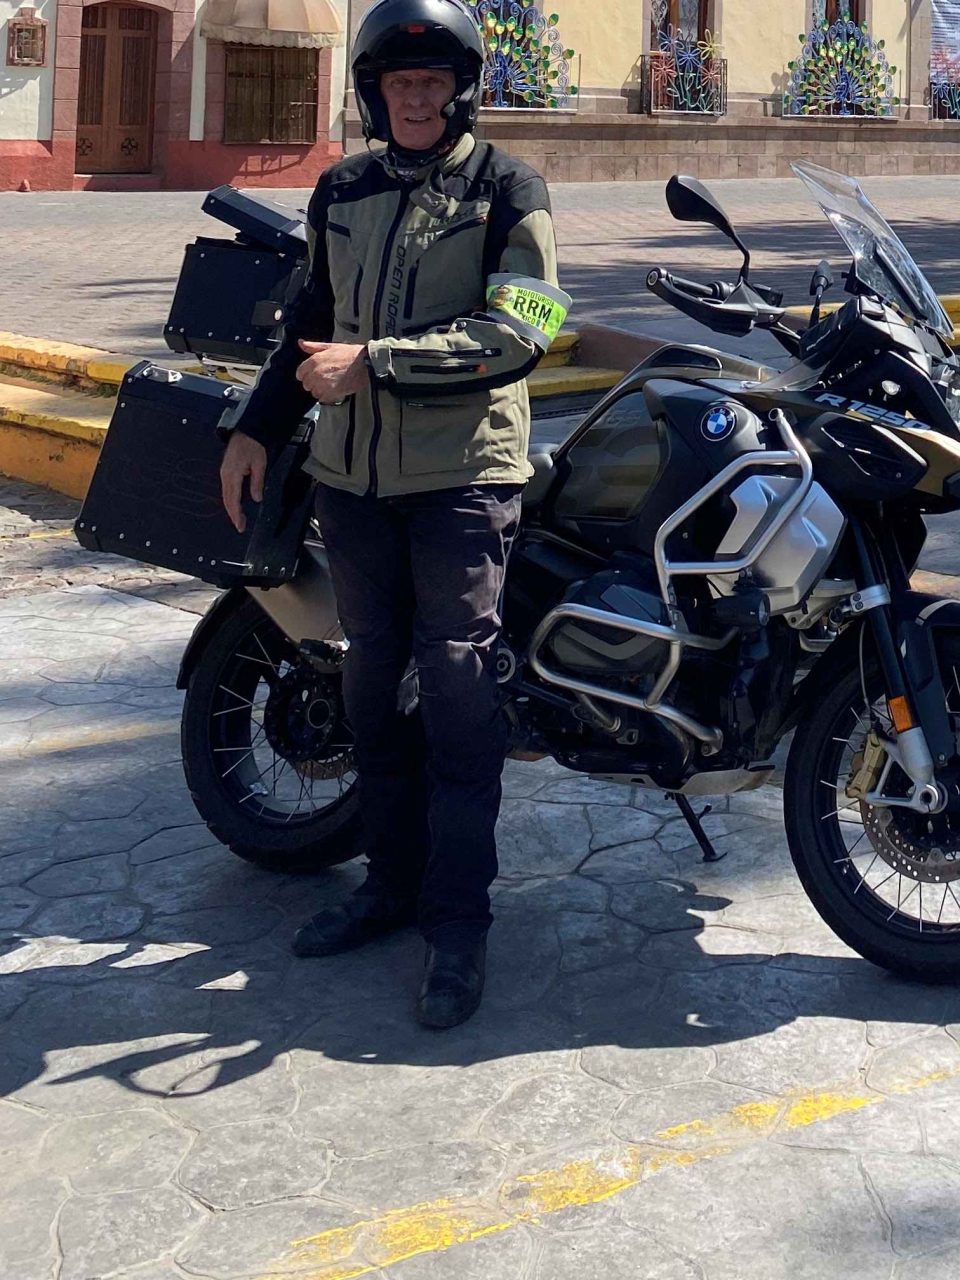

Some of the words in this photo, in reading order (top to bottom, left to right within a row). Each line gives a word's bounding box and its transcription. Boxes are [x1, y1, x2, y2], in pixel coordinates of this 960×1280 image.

[391, 245, 406, 290] OPEN
[513, 295, 552, 323] RRM
[815, 393, 847, 407] R
[847, 400, 931, 430] 1250
